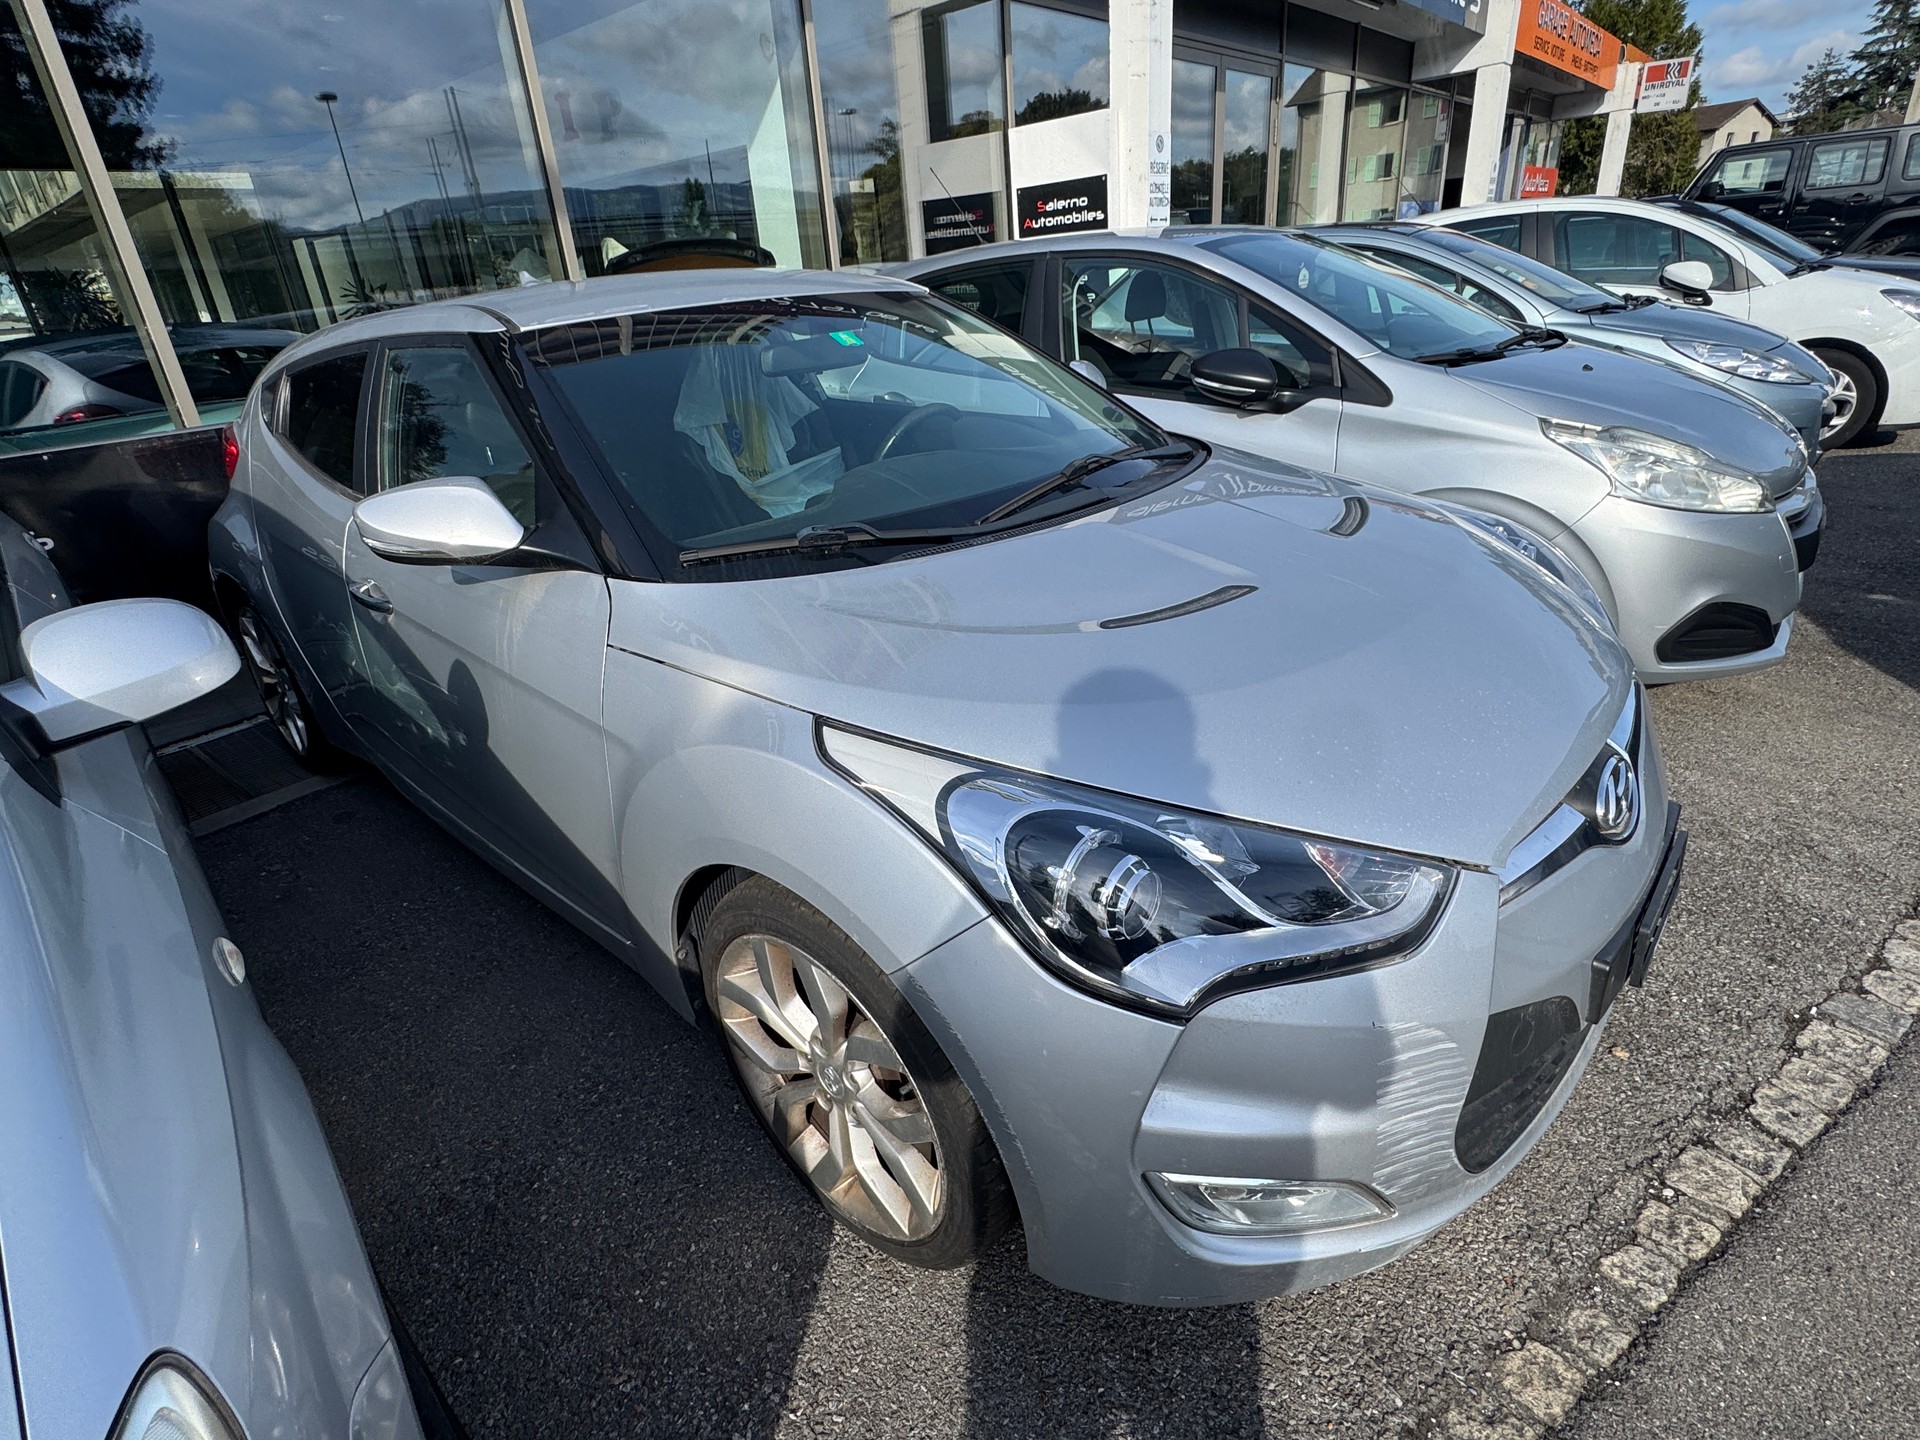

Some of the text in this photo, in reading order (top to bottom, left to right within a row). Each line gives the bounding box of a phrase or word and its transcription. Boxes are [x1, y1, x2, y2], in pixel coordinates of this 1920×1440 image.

[1538, 0, 1569, 41] GARAGE
[1645, 79, 1686, 91] UNIROYAL
[1037, 196, 1088, 212] Salerno
[1023, 209, 1105, 229] Automobiles
